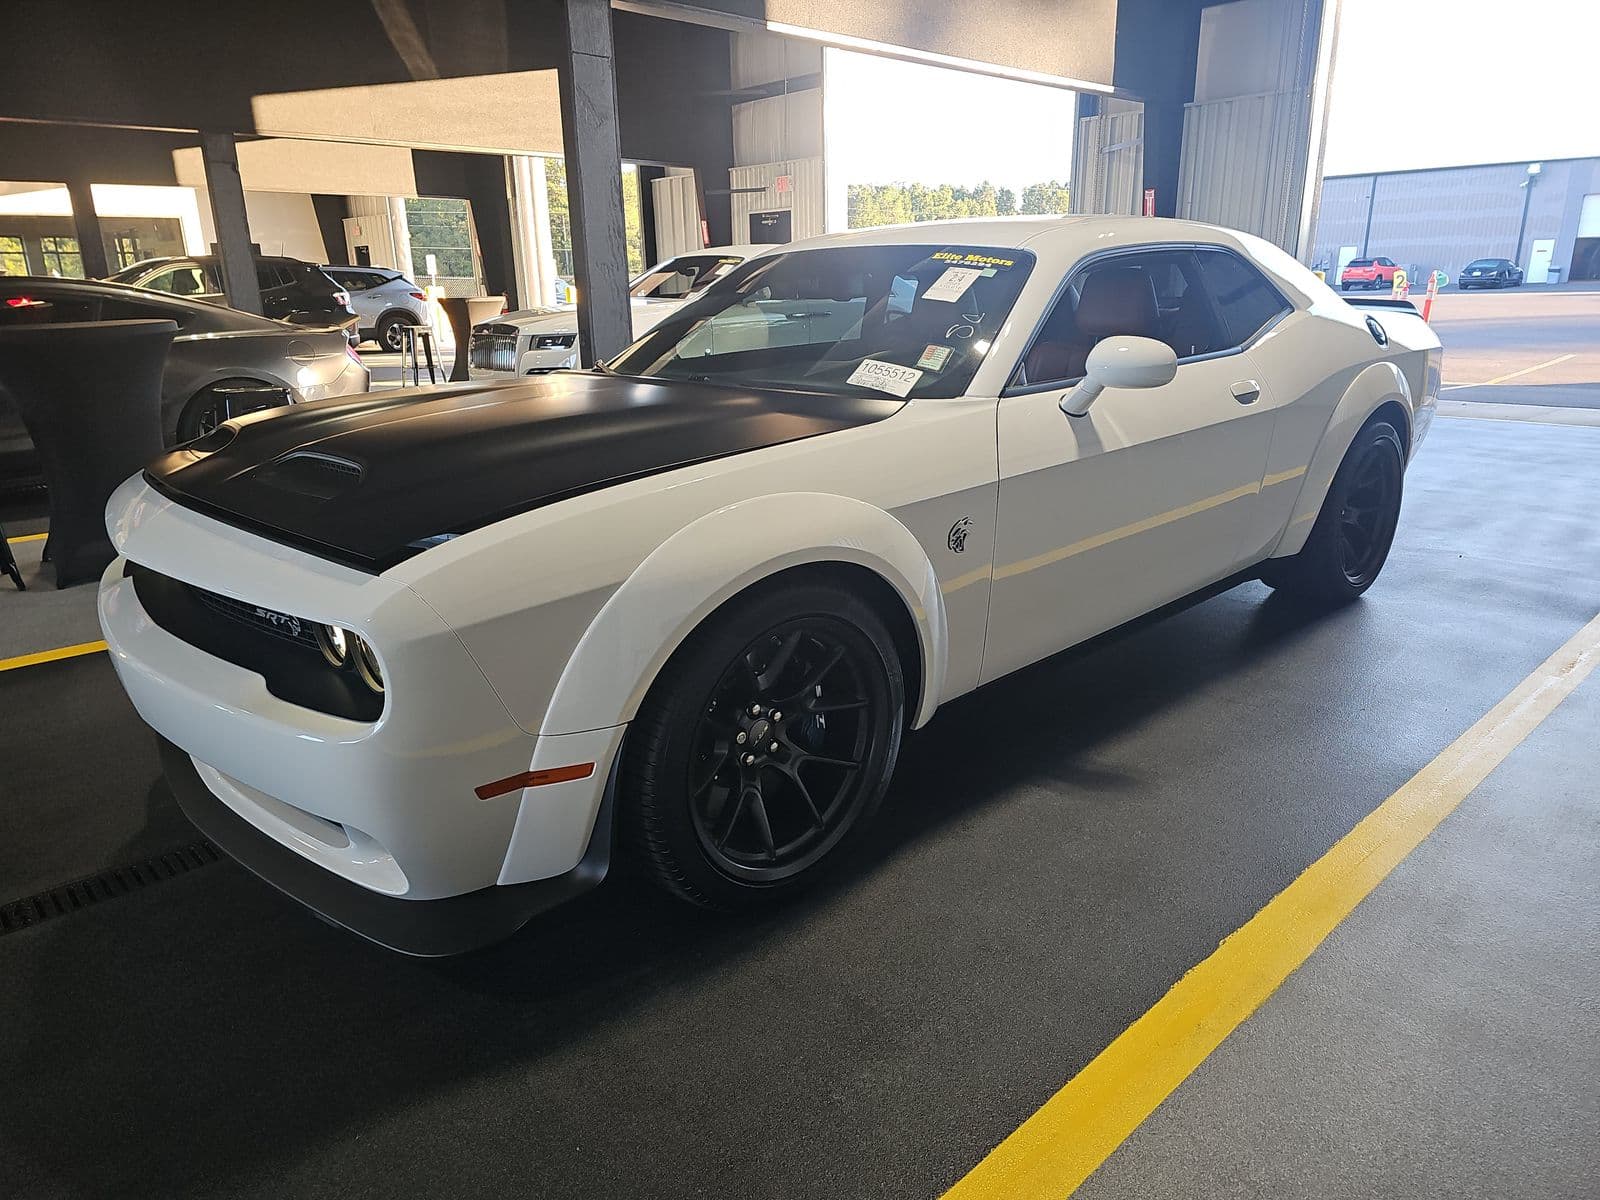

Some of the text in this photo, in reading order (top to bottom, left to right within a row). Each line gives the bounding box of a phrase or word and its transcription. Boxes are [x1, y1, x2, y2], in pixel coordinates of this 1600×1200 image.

[931, 252, 1014, 266] Elite Motors
[1396, 274, 1405, 288] 2
[862, 362, 916, 383] 1055512
[254, 608, 290, 625] SRT
